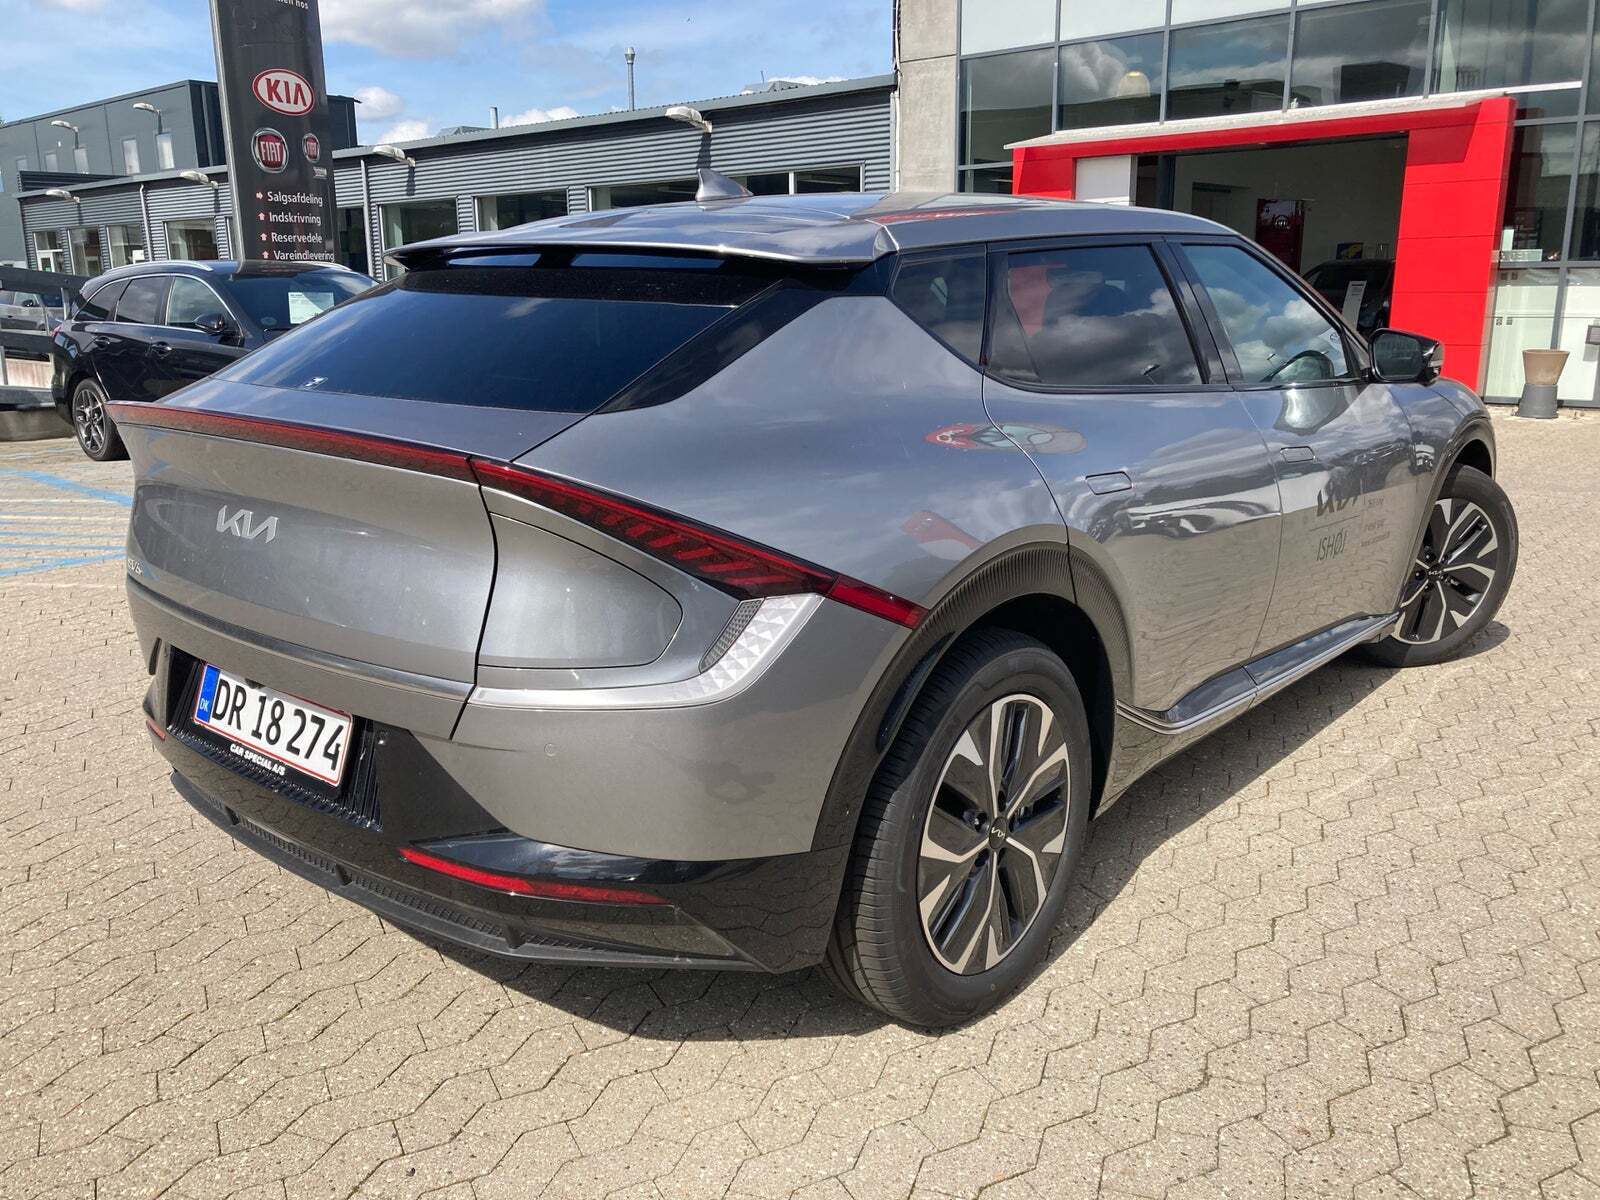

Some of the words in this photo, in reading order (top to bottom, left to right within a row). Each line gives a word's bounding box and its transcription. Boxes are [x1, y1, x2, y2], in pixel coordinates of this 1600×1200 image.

[265, 78, 307, 107] KIA
[260, 141, 281, 161] FIAT
[267, 191, 323, 207] Salgsafdeling
[269, 212, 321, 226] Indskrivning
[271, 232, 323, 243] Reservedele
[273, 250, 335, 262] Vareindlevering
[215, 505, 279, 543] KIA
[199, 697, 209, 713] DK
[211, 679, 247, 731] DR
[251, 695, 285, 746] 18
[286, 708, 345, 771] 274
[230, 743, 245, 757] CAR
[243, 750, 273, 771] SPECIAL
[271, 763, 286, 776] A/S
